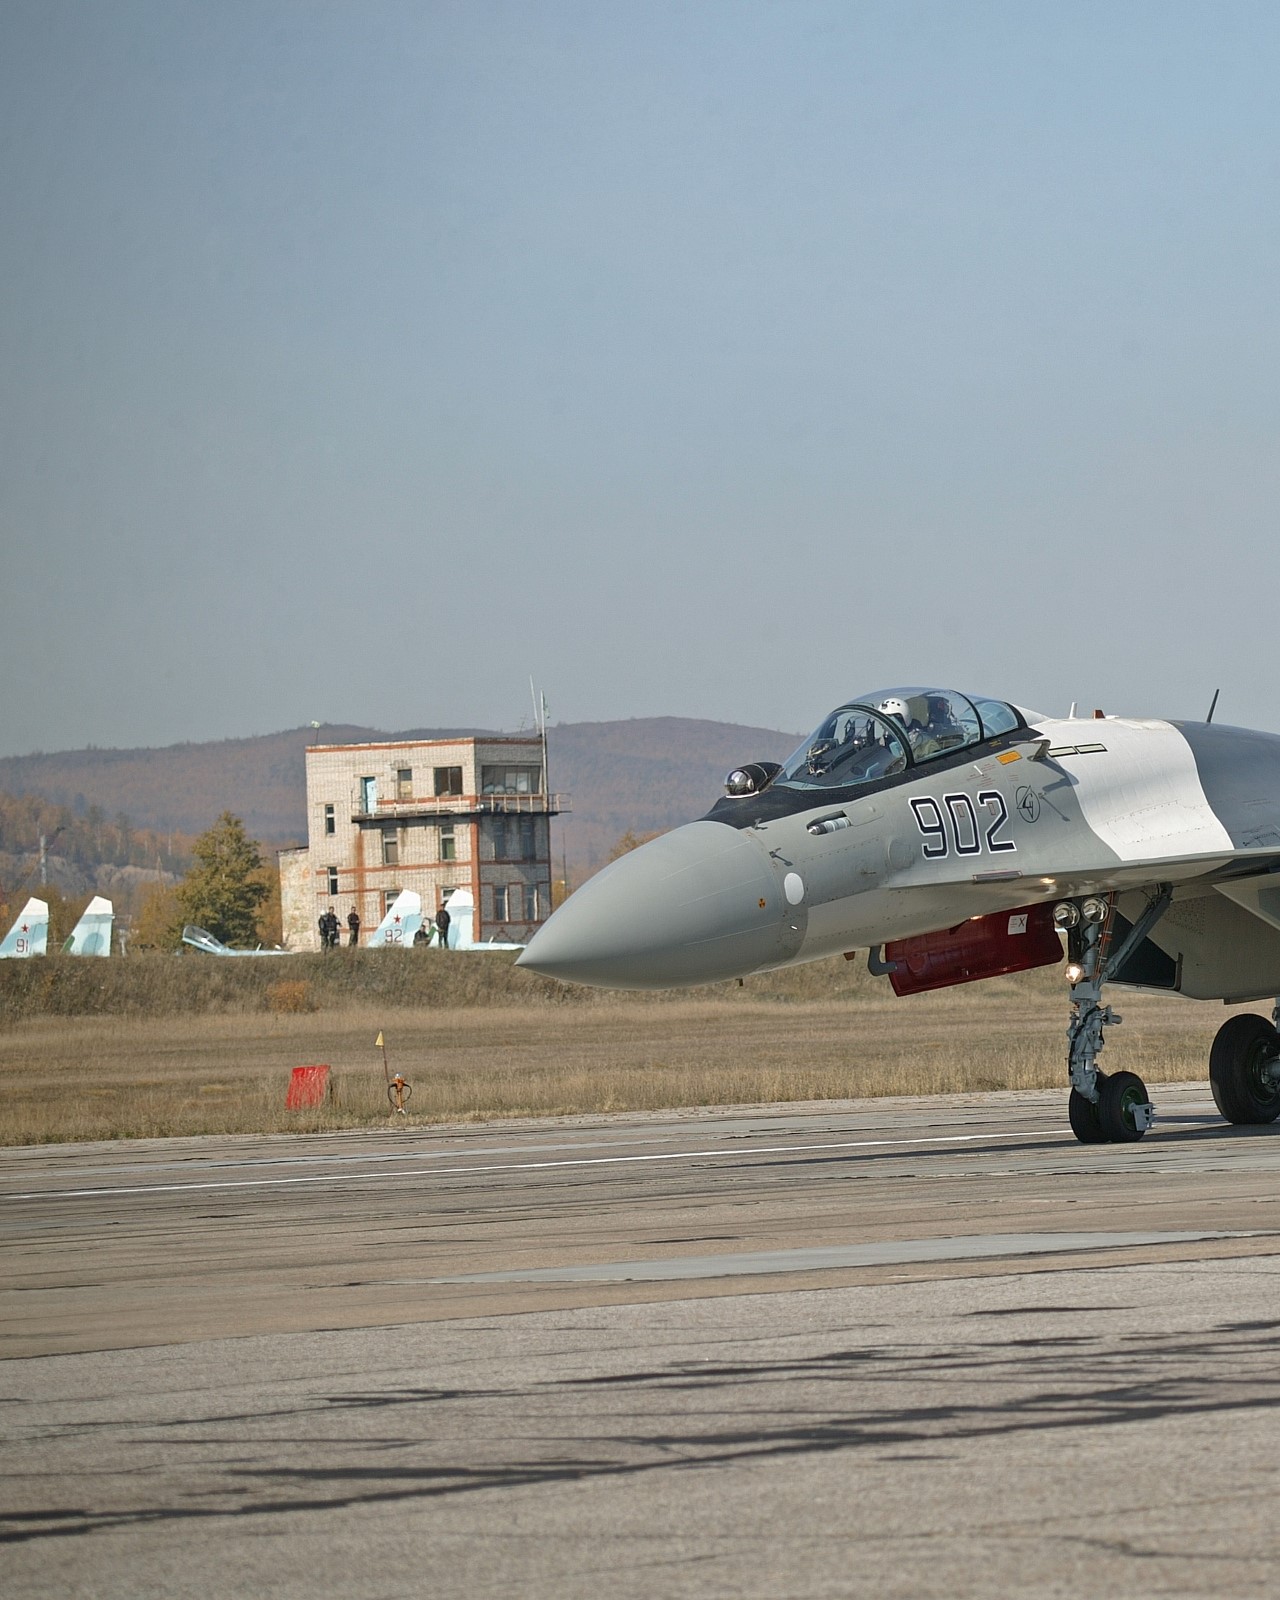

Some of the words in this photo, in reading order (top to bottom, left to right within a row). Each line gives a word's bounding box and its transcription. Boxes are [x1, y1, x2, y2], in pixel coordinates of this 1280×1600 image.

[908, 790, 1017, 860] 902
[385, 928, 403, 943] 92
[16, 938, 29, 953] 91
